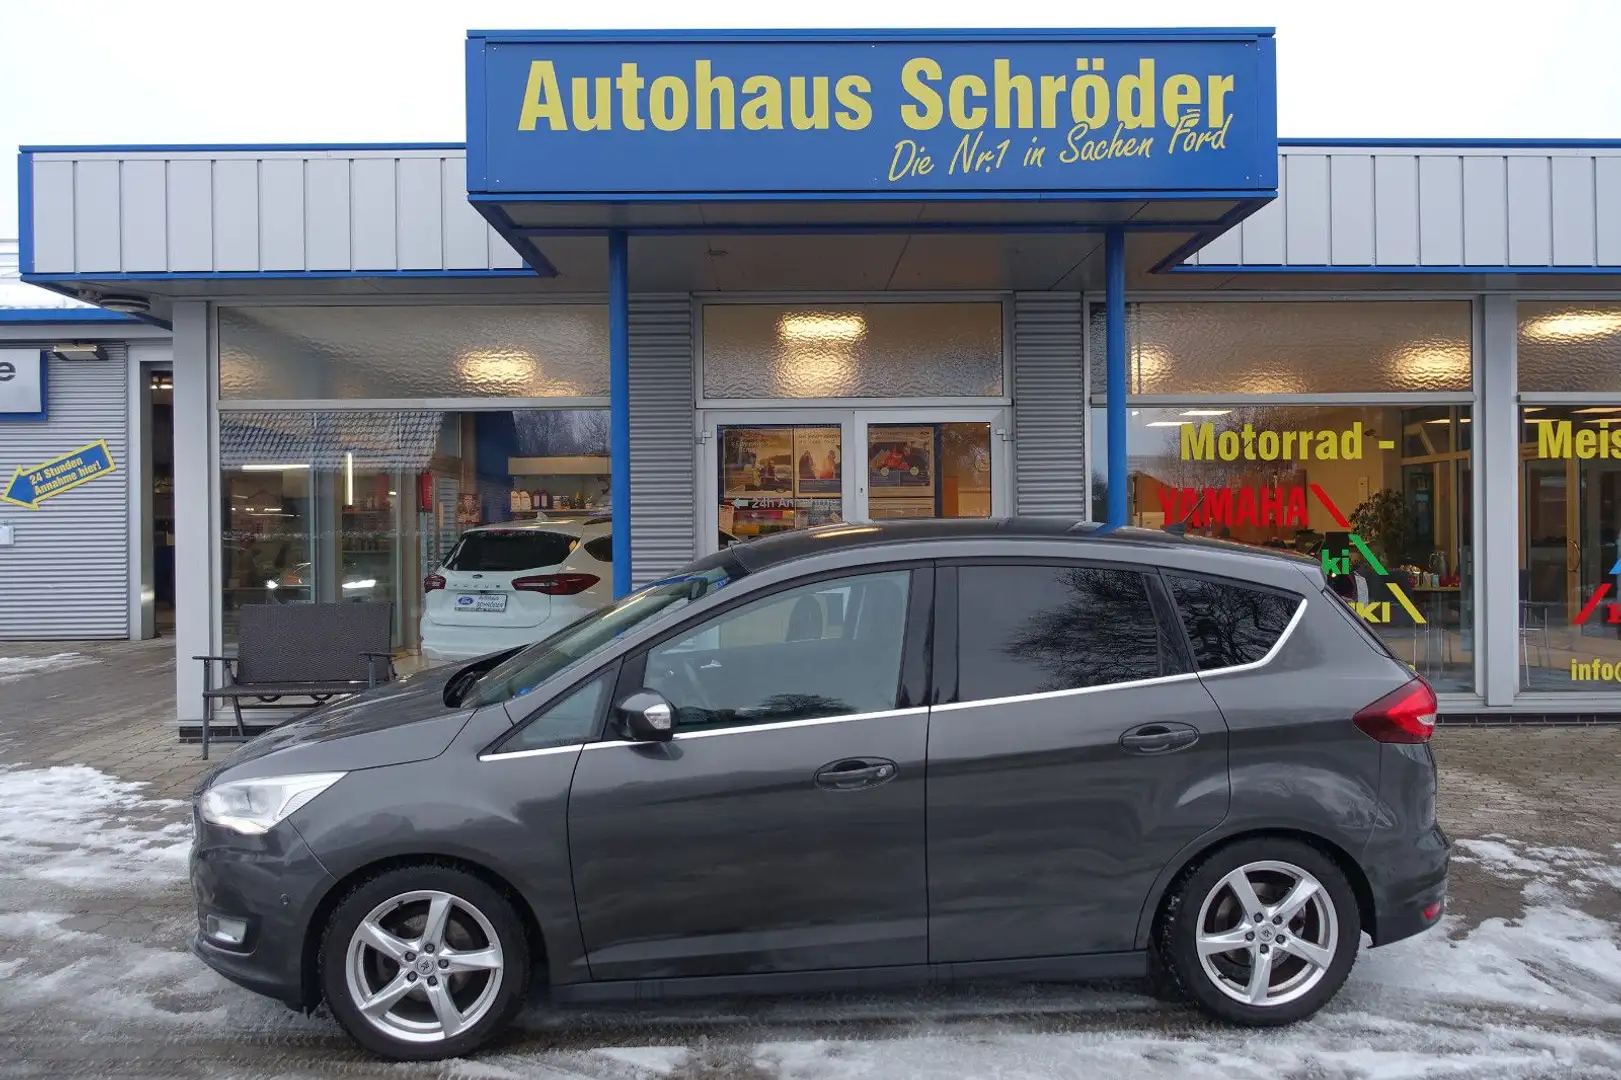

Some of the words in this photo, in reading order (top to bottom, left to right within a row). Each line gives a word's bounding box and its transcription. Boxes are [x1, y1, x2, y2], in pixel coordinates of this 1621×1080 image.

[518, 60, 873, 131] Autohaus
[901, 57, 1234, 130] Schröder
[888, 139, 934, 182] Die
[949, 131, 1010, 174] Nr.1
[1023, 136, 1046, 167] in
[1060, 122, 1154, 163] Sachen
[1168, 109, 1233, 153] Ford
[1180, 421, 1362, 461] Motorrad
[29, 473, 43, 485] 24
[44, 457, 83, 479] Stunden
[34, 471, 77, 496] Annahme
[78, 460, 101, 477] hier!
[1157, 486, 1309, 528] YAMAHA
